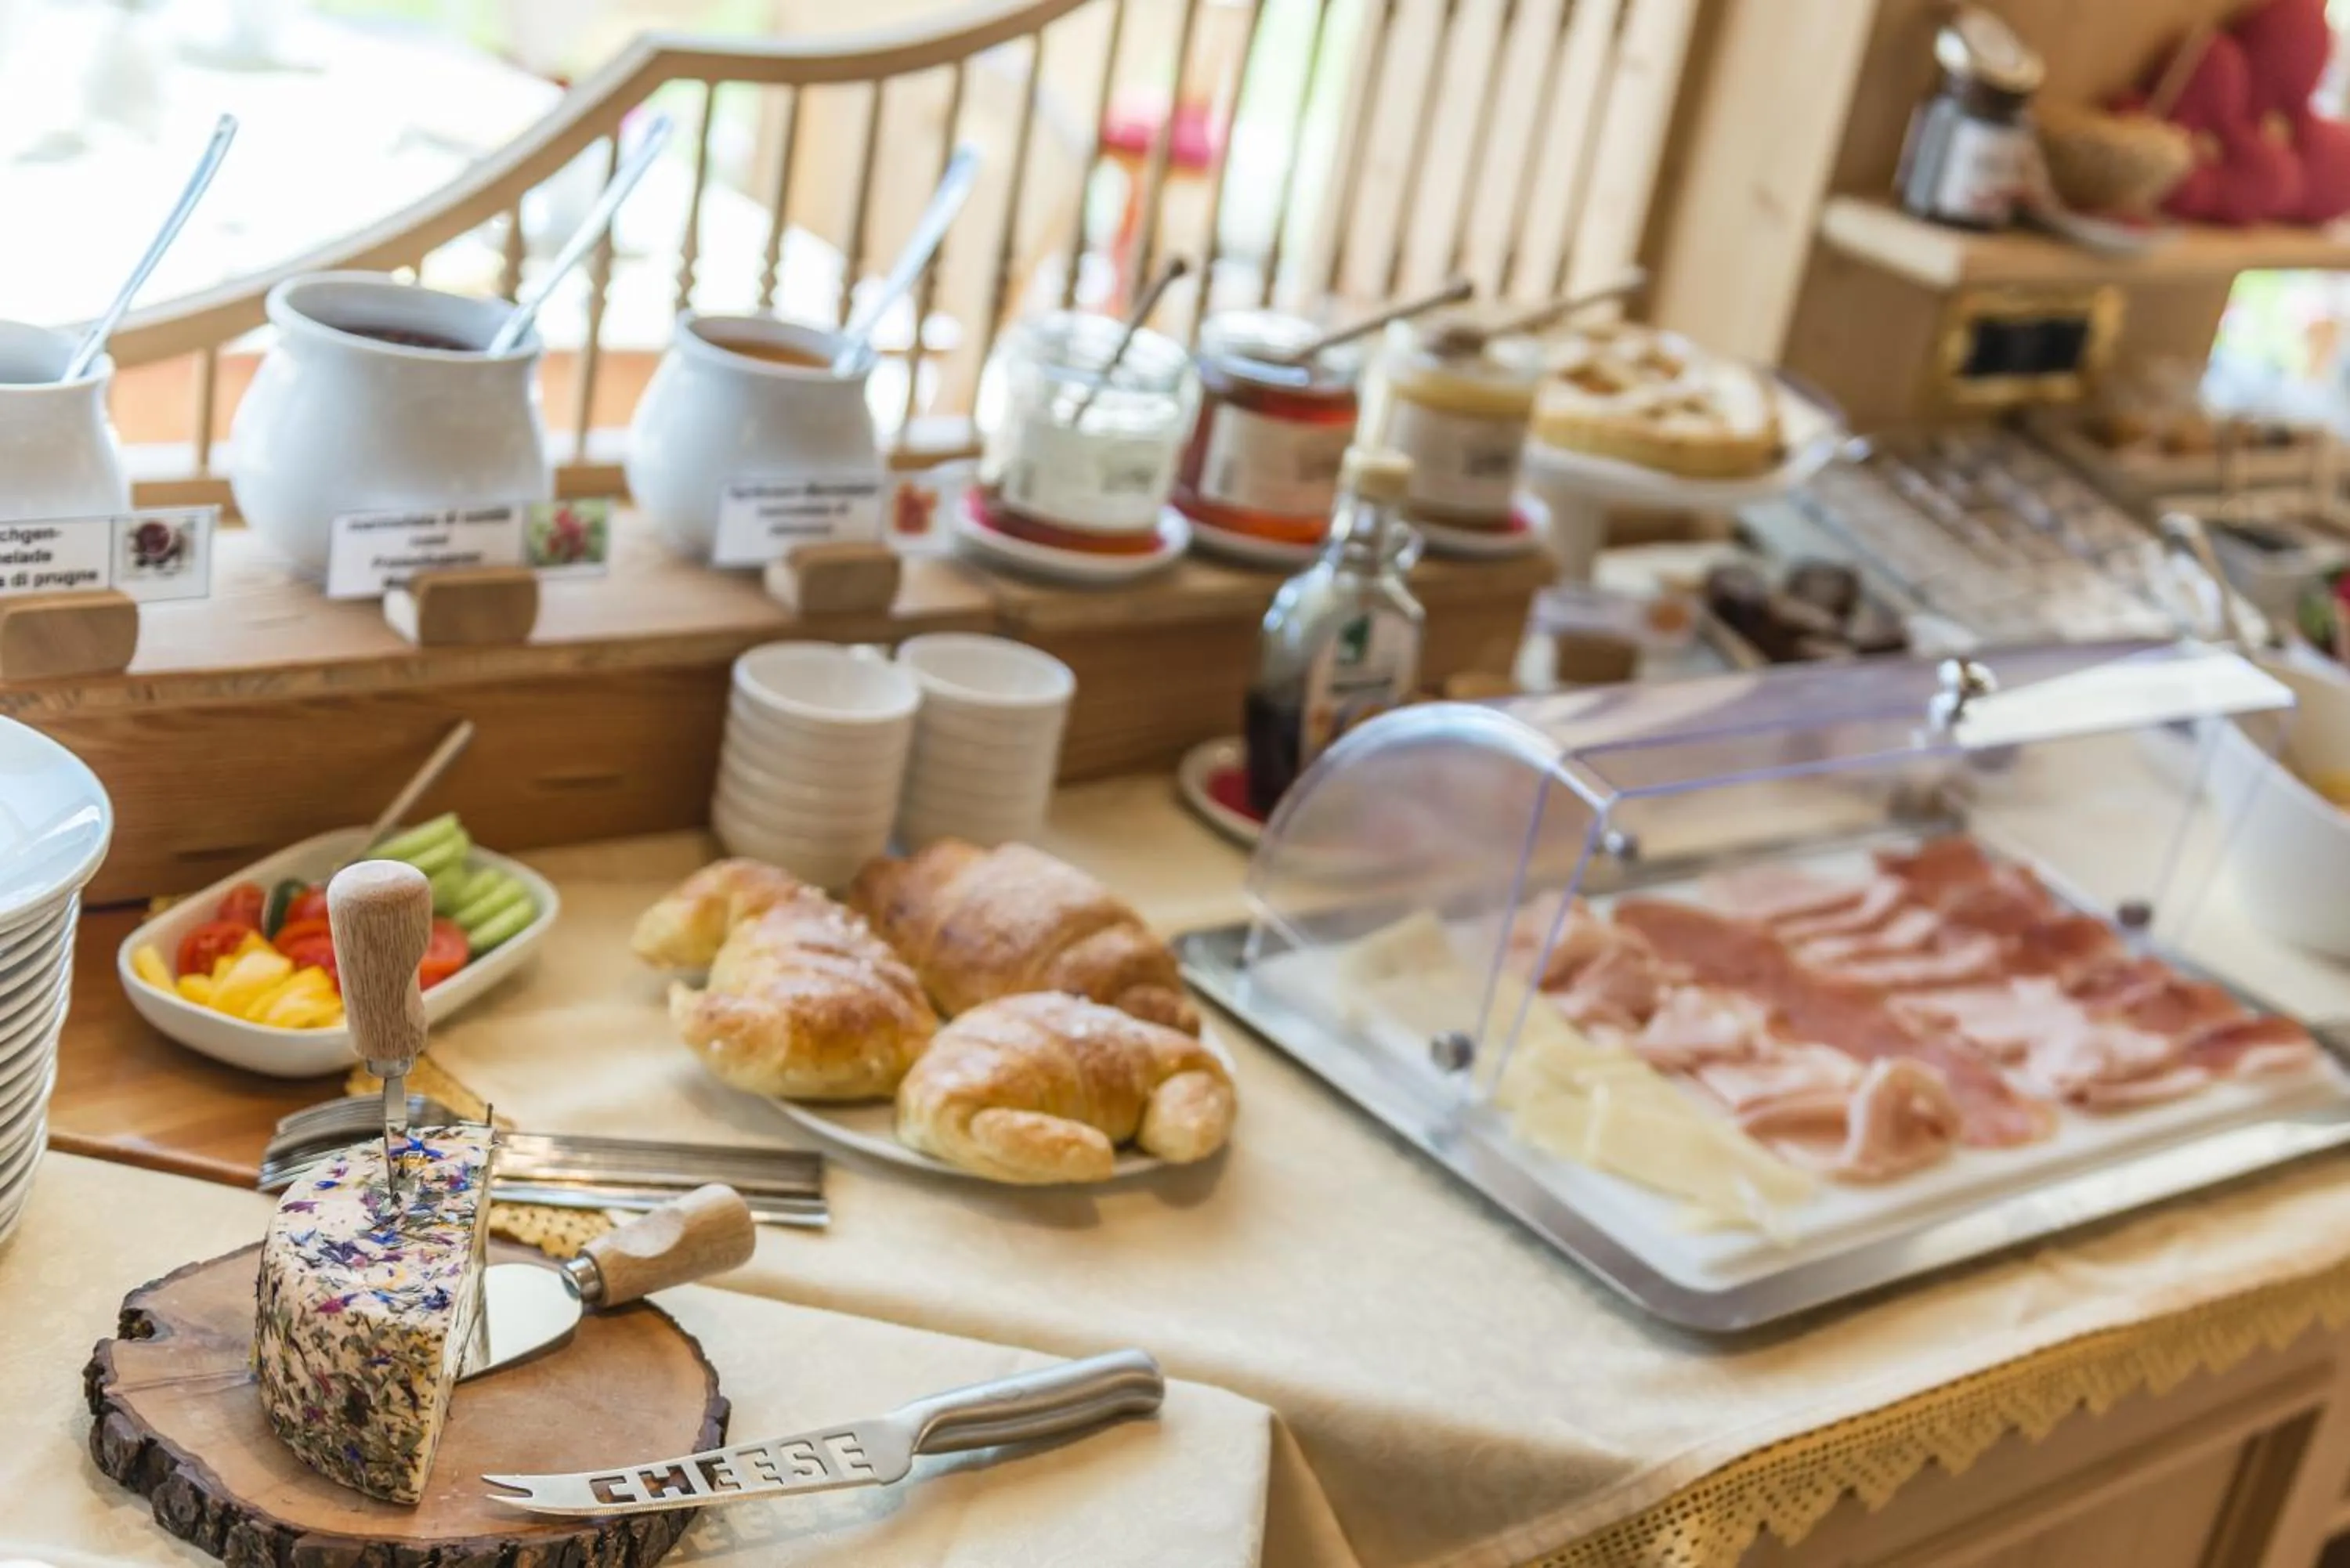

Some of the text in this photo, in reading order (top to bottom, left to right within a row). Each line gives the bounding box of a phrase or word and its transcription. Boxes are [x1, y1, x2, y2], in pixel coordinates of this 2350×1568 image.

[11, 573, 27, 587] di
[34, 571, 98, 587] prugne
[590, 1432, 873, 1504] CHEESE
